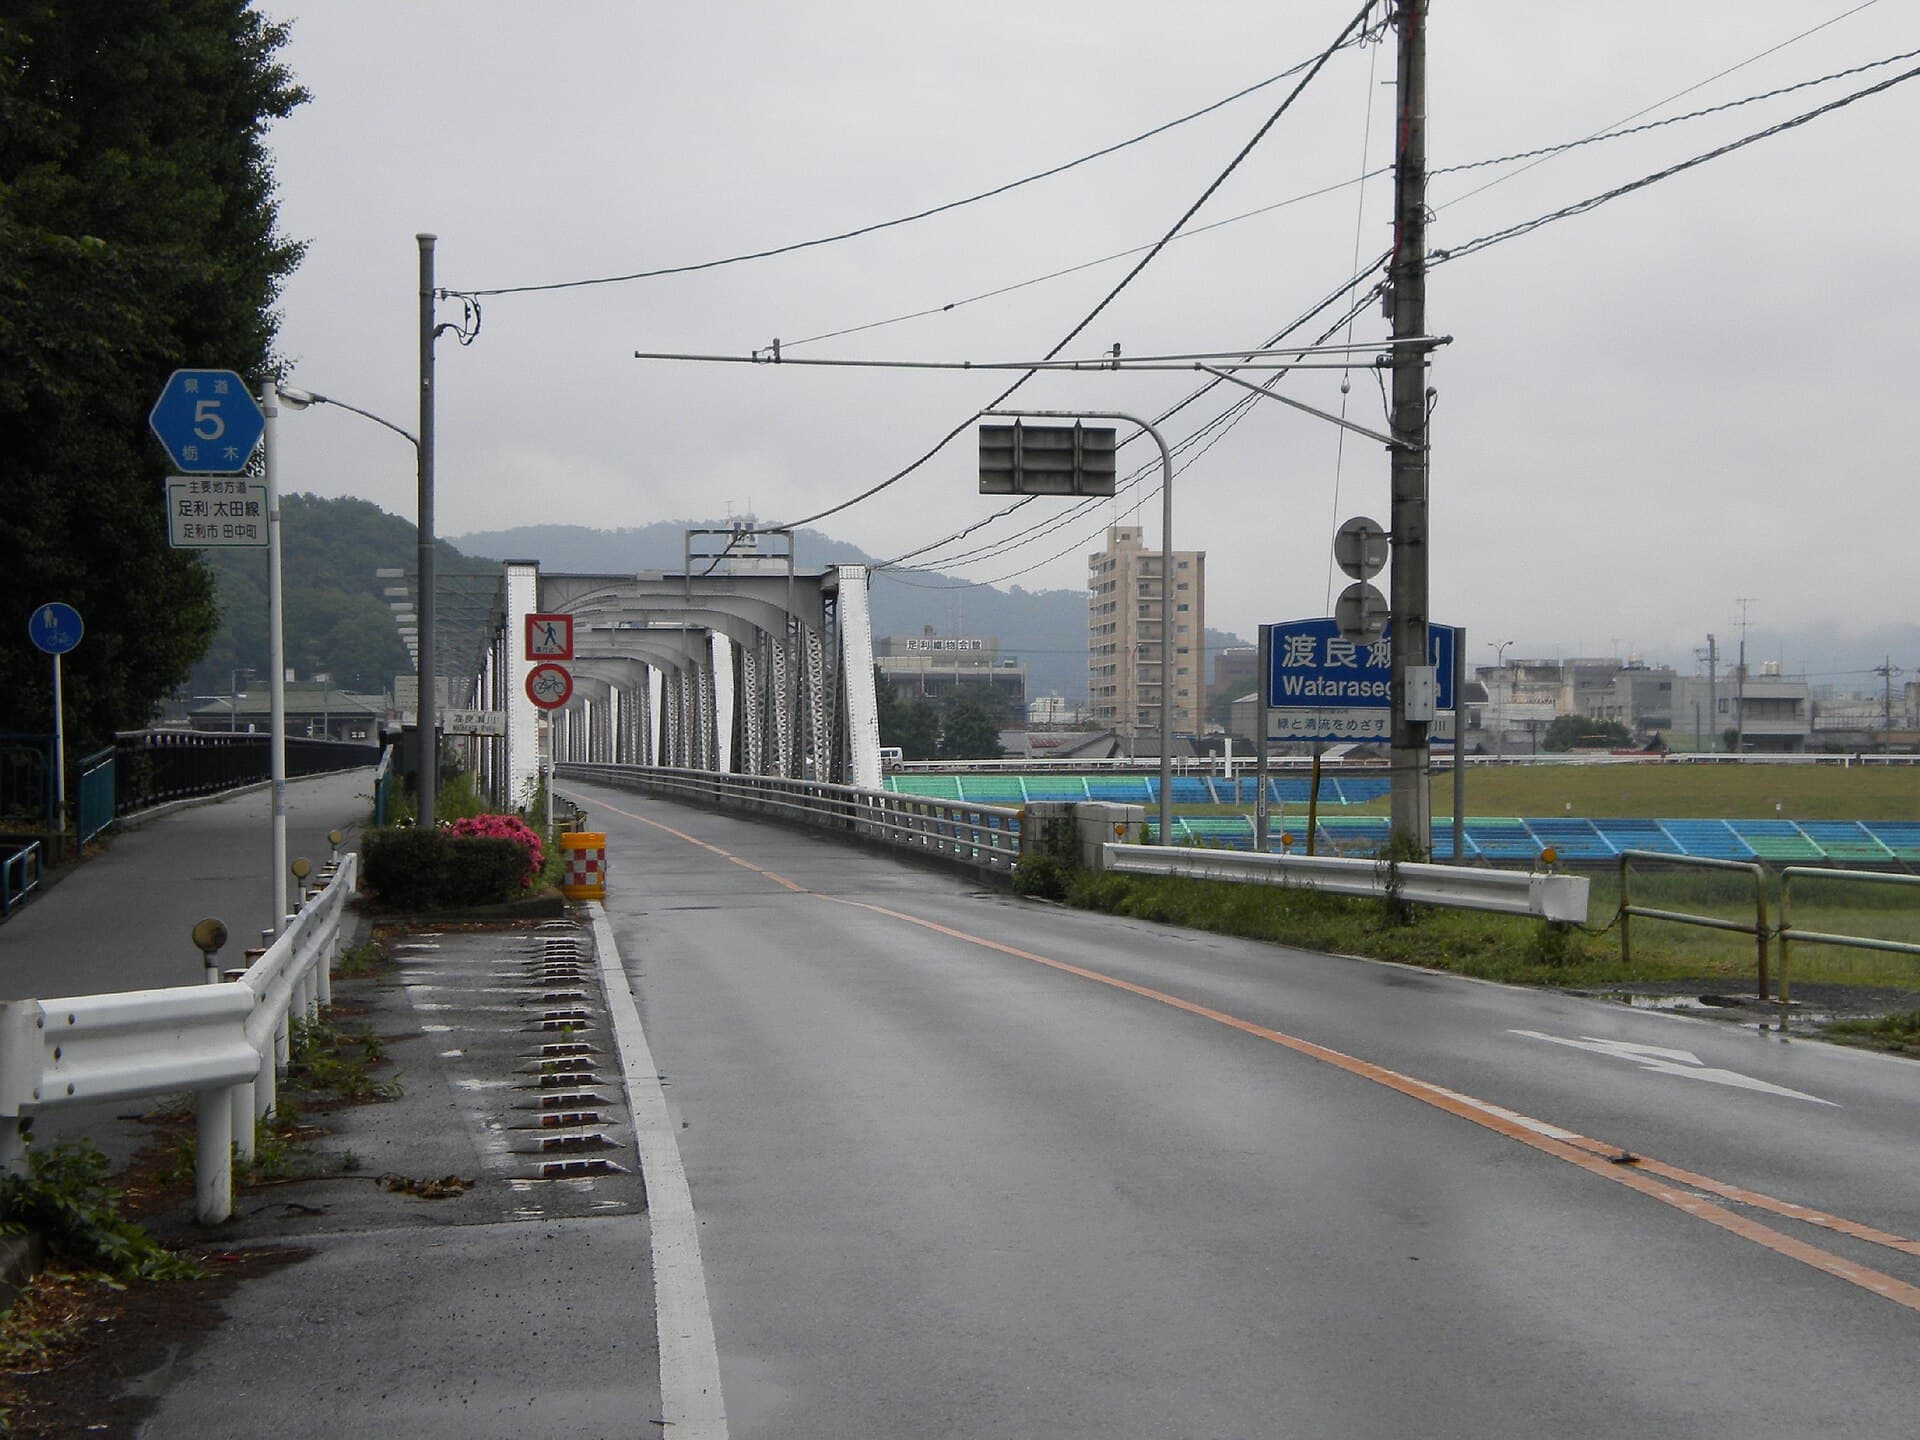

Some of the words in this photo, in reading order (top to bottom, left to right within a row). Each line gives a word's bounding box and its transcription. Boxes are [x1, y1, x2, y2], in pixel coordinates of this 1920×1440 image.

[193, 400, 225, 440] 5
[188, 481, 248, 495] 主要地方道
